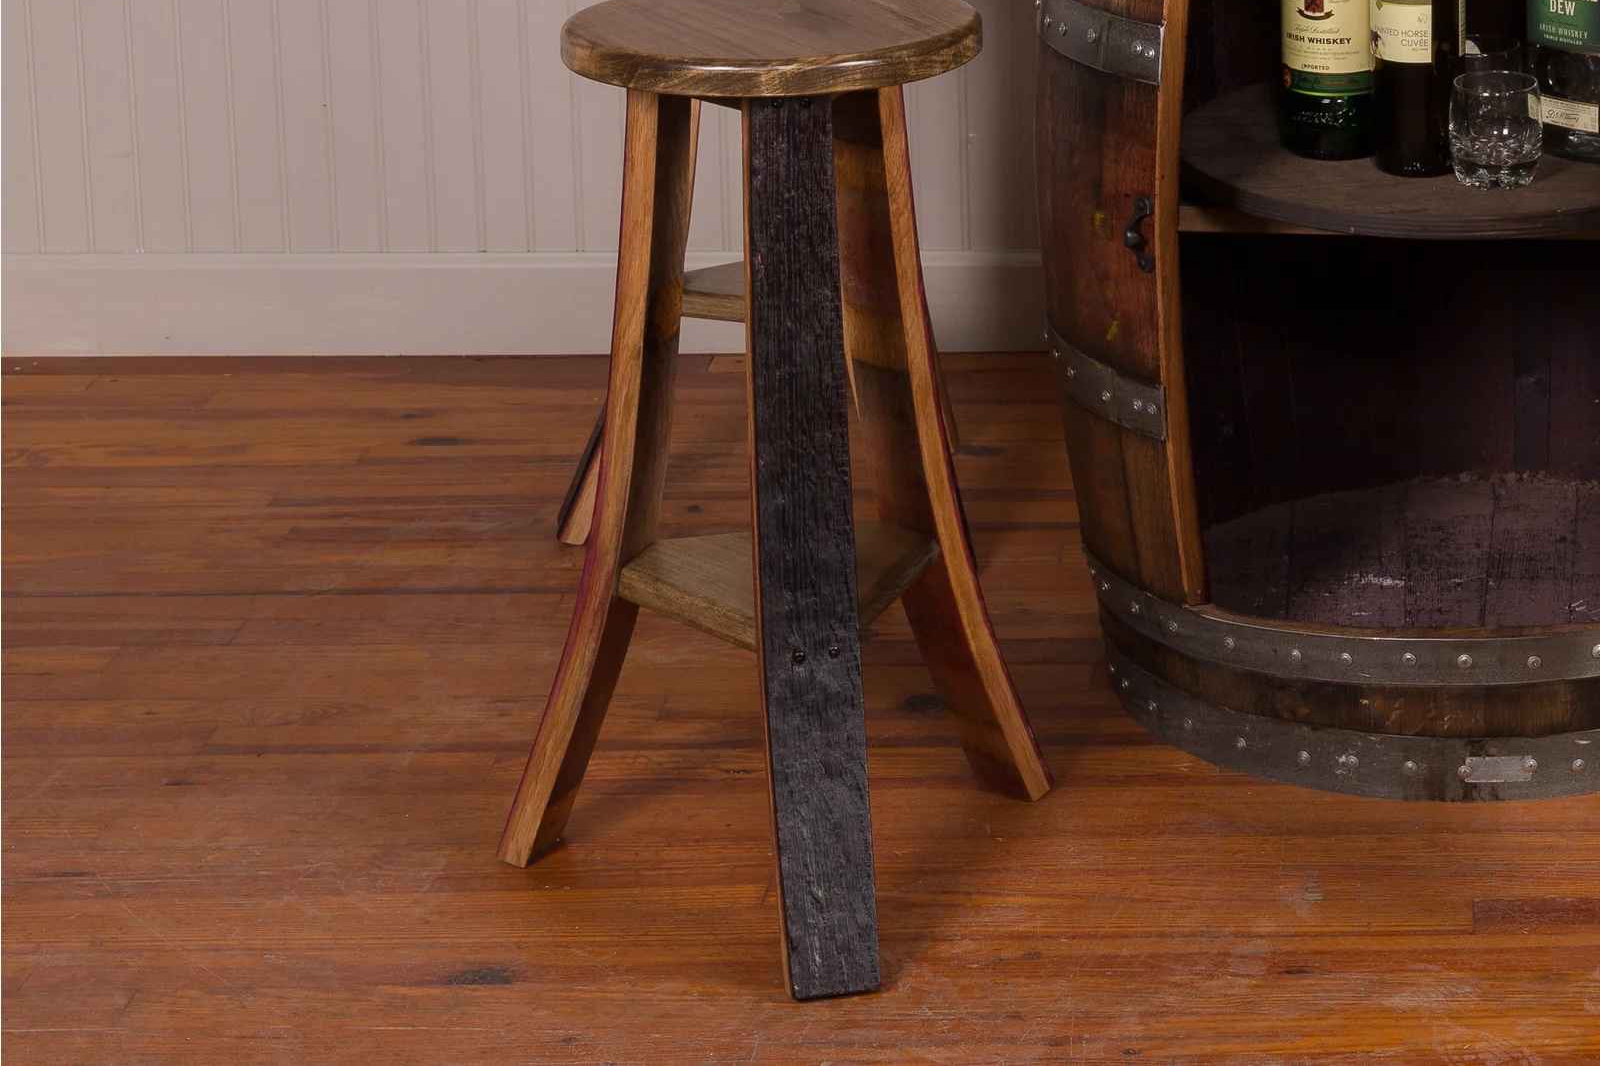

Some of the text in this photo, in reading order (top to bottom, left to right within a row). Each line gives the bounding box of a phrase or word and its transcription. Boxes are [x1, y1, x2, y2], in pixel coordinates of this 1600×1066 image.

[1286, 31, 1352, 45] IRISH WHISKEY
[1401, 29, 1429, 38] HORSE
[1301, 63, 1330, 71] IMPORTED
